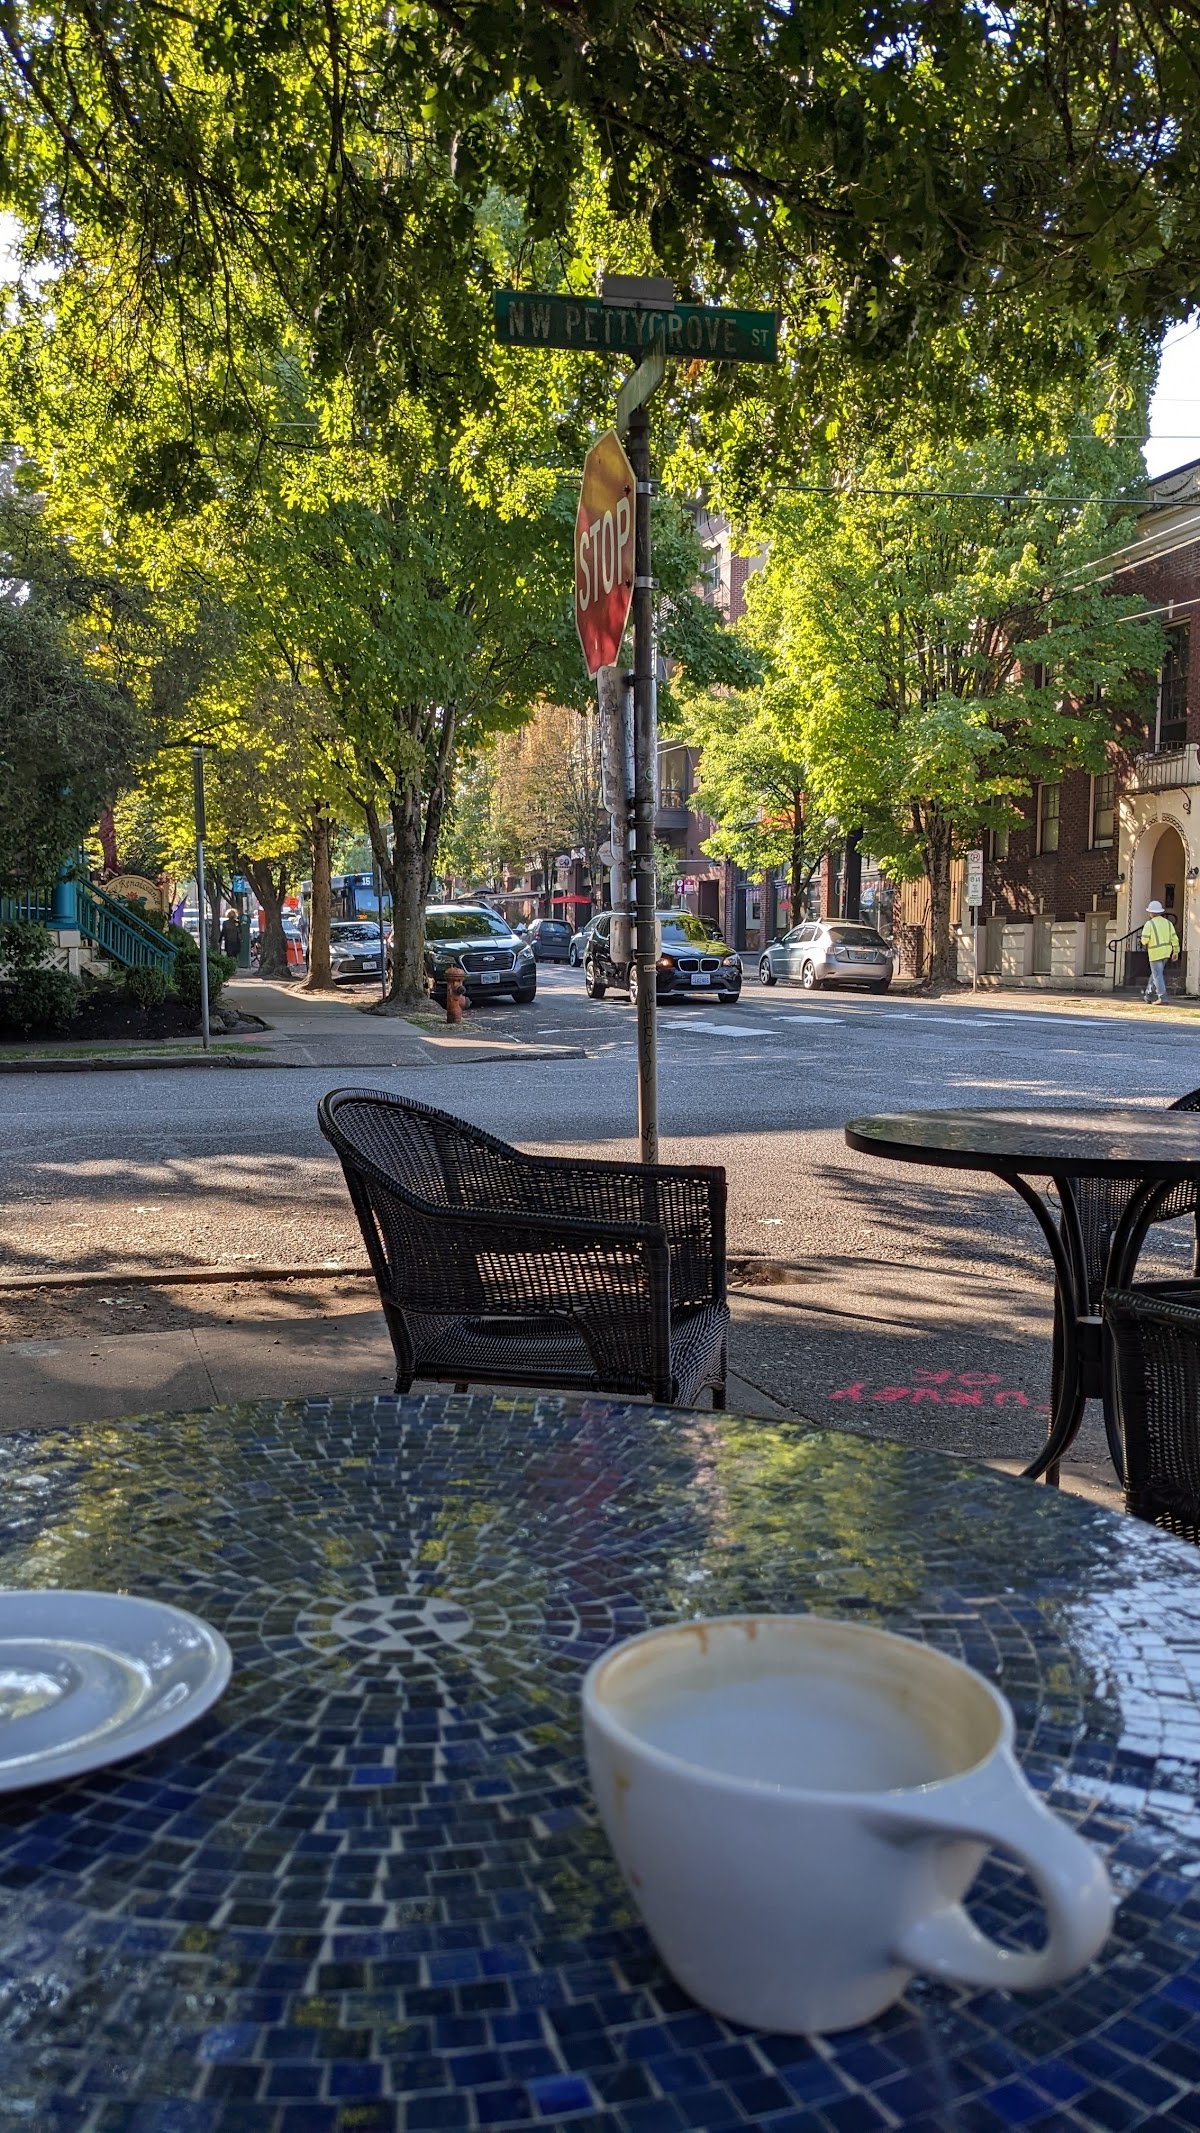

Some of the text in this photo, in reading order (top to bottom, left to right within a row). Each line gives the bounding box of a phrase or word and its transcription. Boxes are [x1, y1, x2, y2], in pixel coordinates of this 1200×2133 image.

[509, 301, 549, 339] NW
[751, 328, 768, 347] ST
[579, 496, 630, 612] STOP
[362, 877, 371, 886] 15
